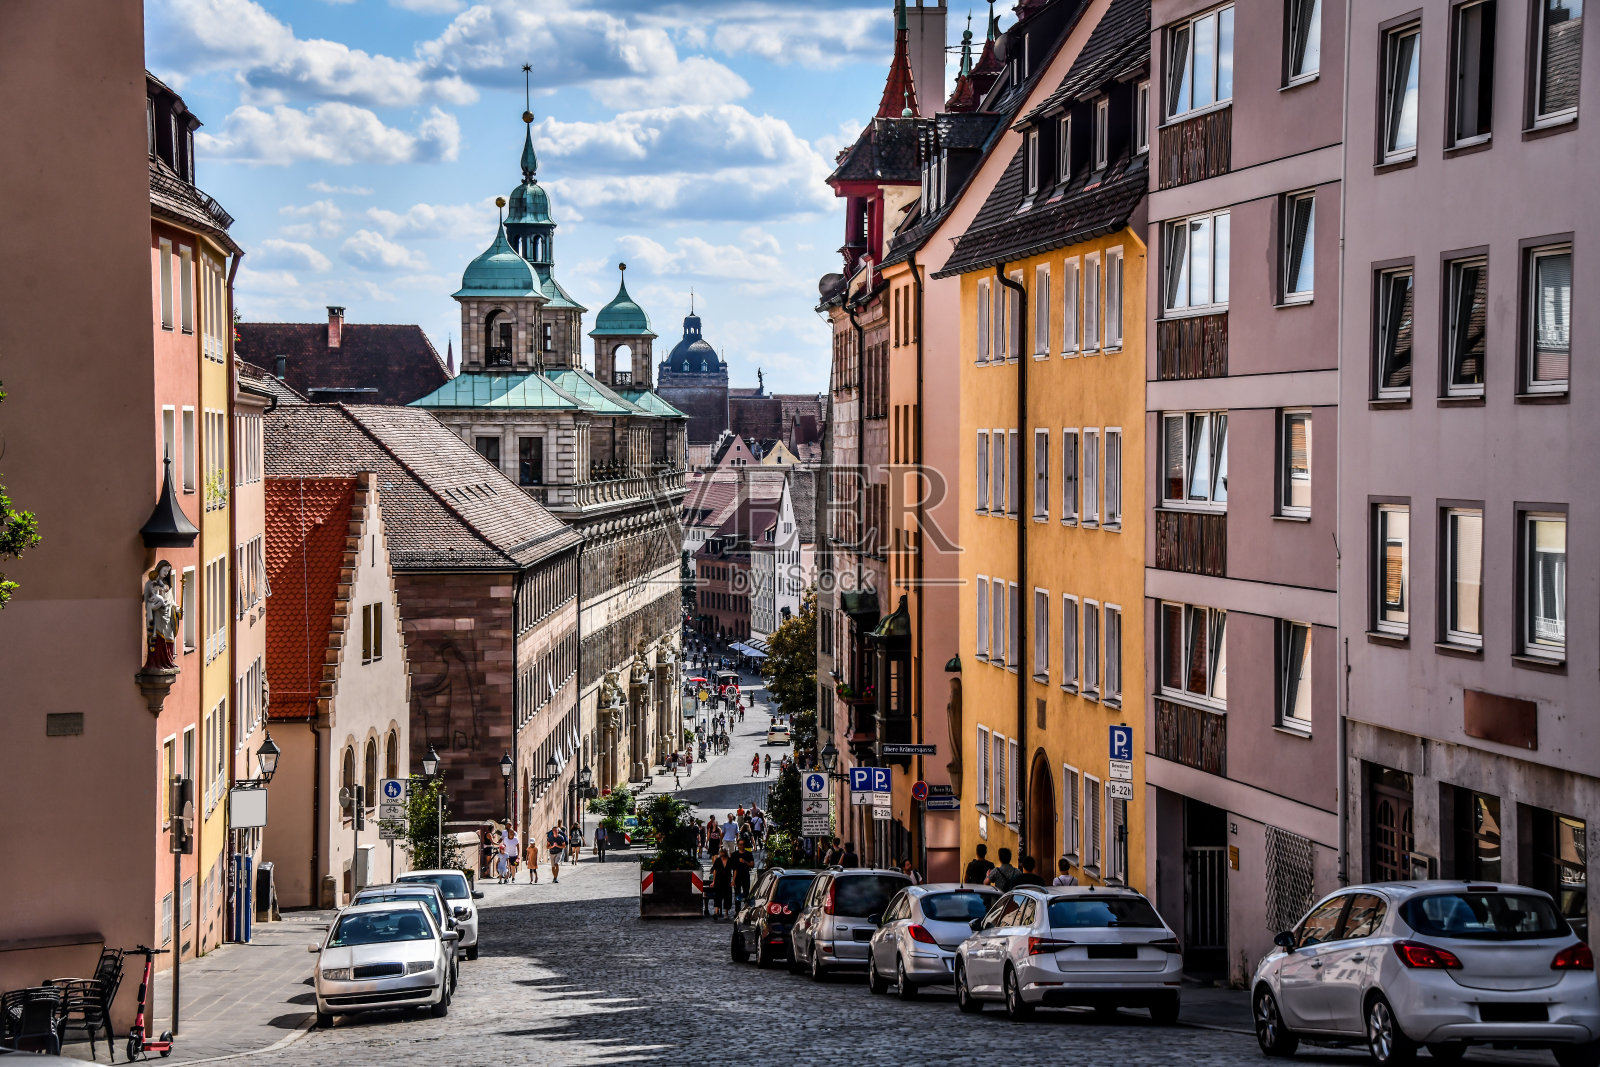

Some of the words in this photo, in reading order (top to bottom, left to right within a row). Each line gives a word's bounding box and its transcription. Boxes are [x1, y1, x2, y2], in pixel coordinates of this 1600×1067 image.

[1115, 730, 1127, 755] P
[855, 770, 868, 788] P
[875, 770, 886, 788] P
[1111, 784, 1131, 796] 8-22h
